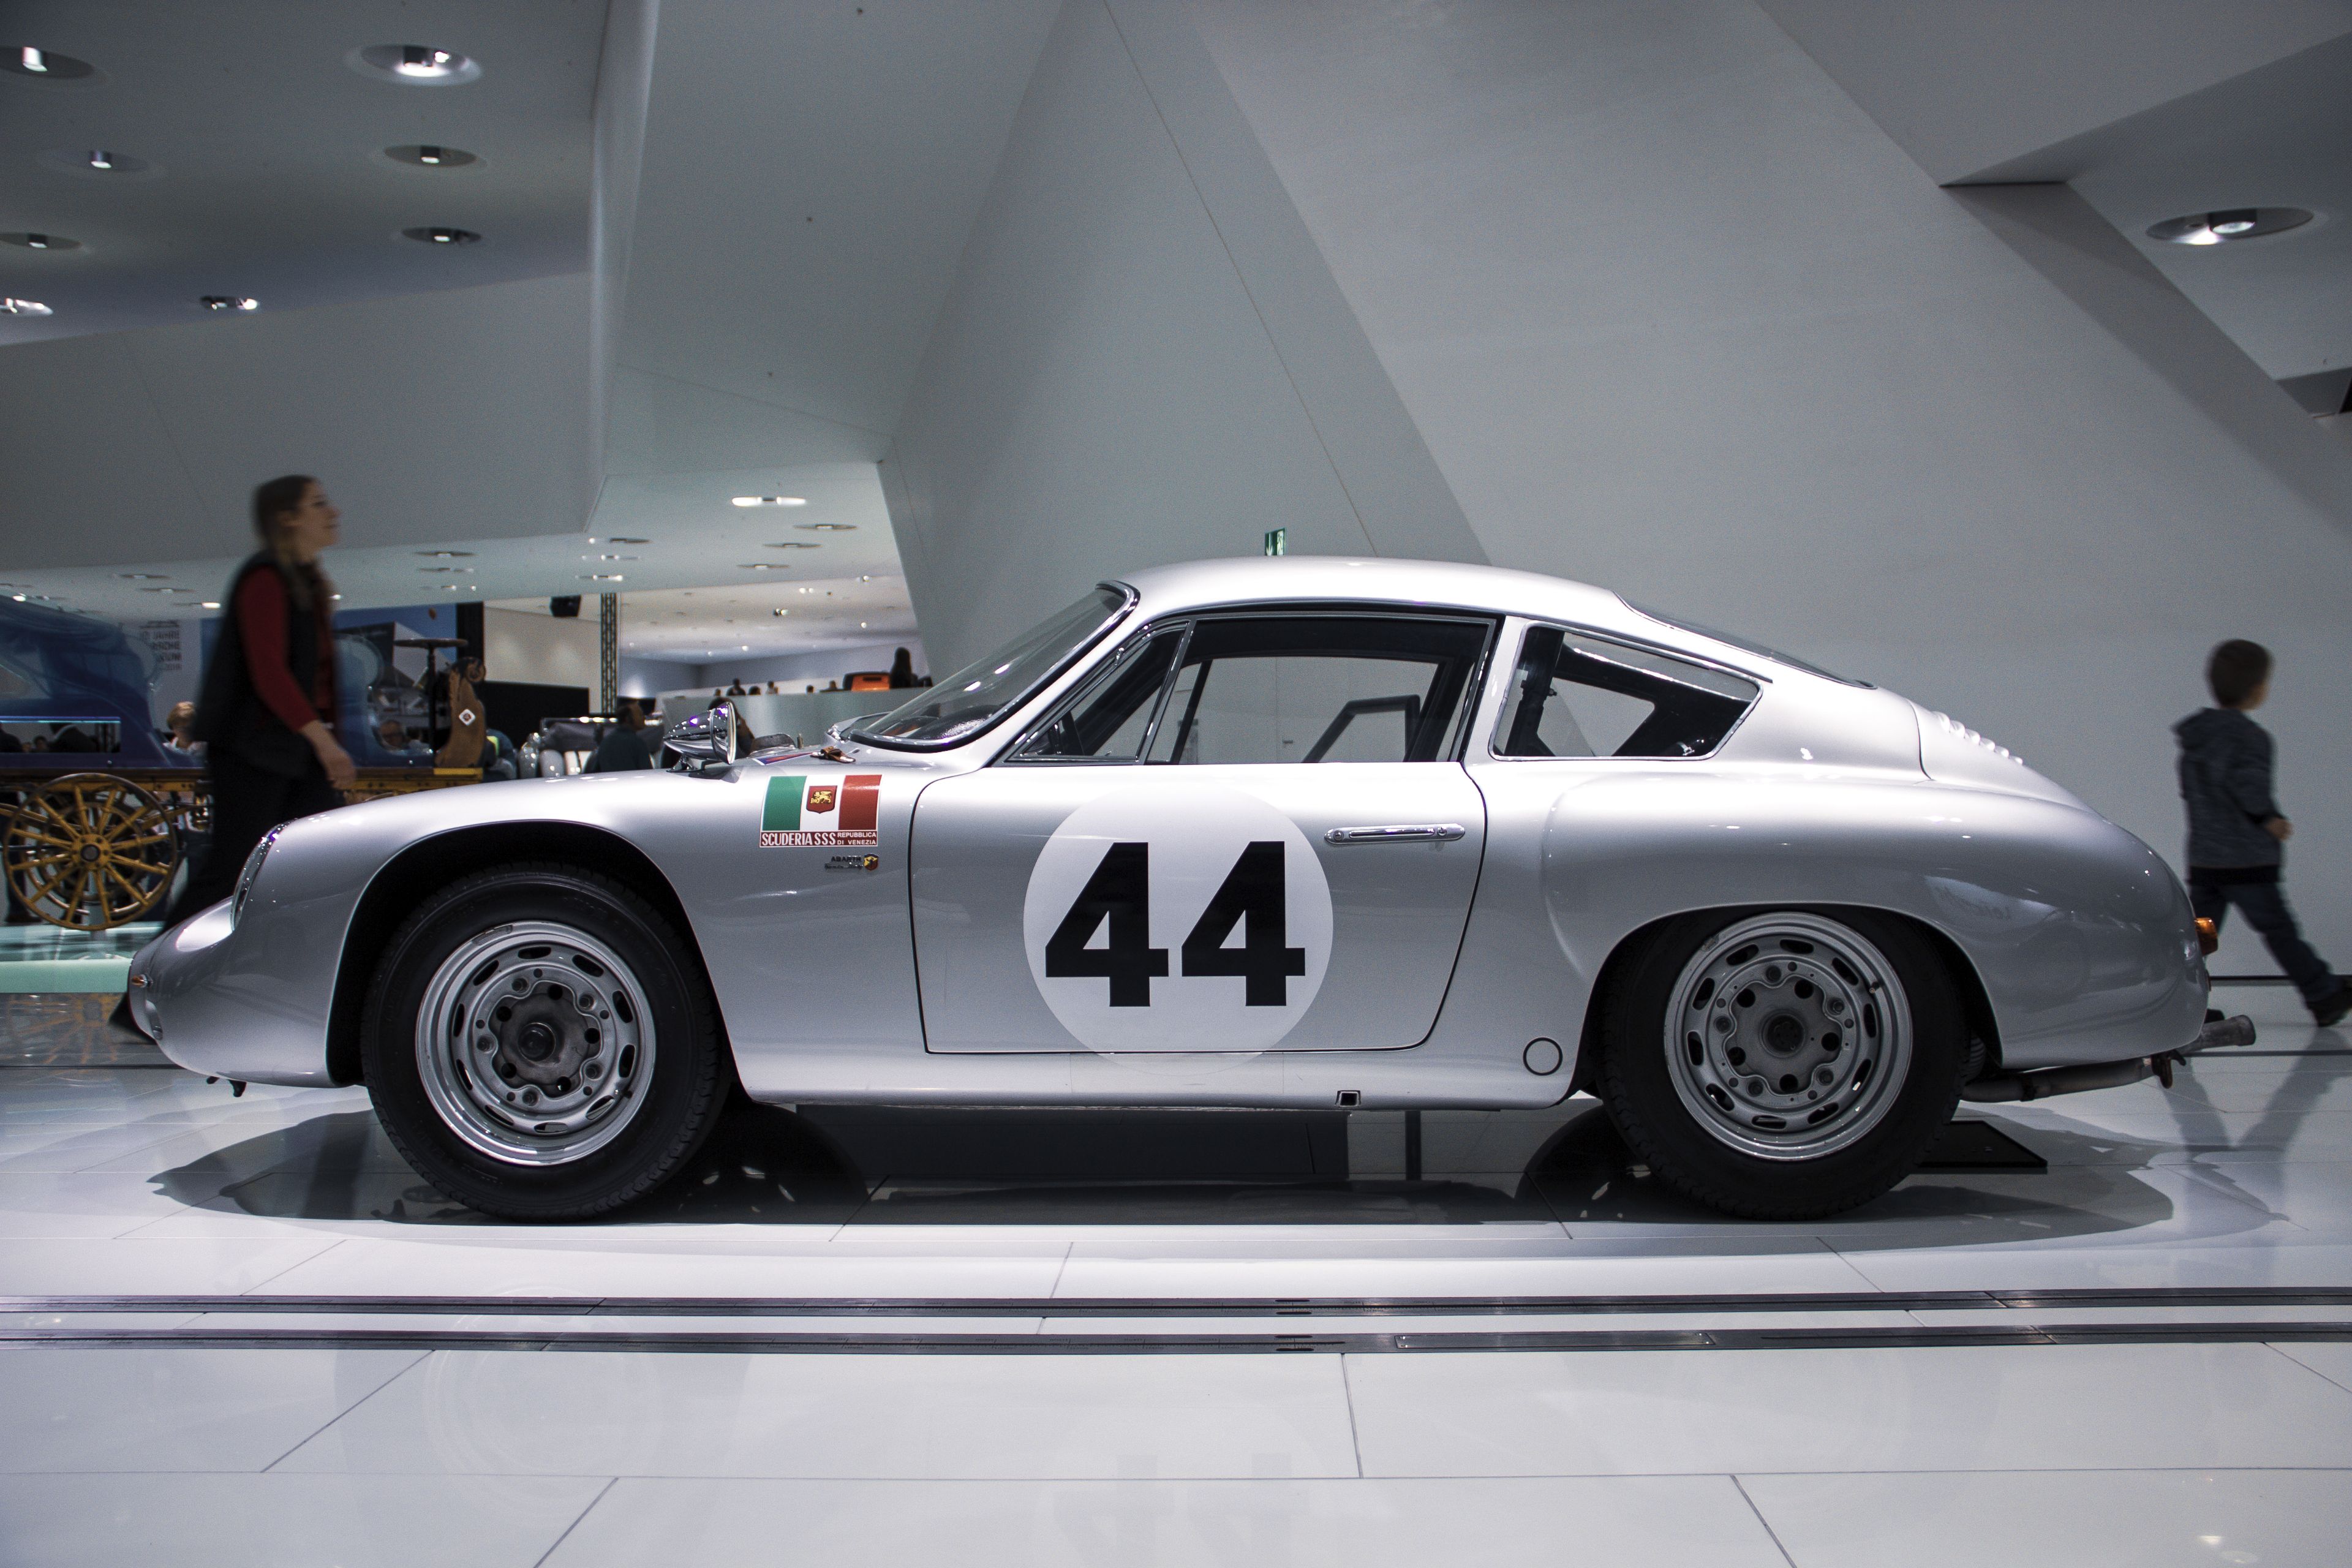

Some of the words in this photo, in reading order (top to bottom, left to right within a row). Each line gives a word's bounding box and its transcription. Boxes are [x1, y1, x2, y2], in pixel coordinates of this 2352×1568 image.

[762, 833, 812, 846] SCUDERIA
[815, 833, 835, 845] SSS
[1046, 841, 1305, 1007] 44
